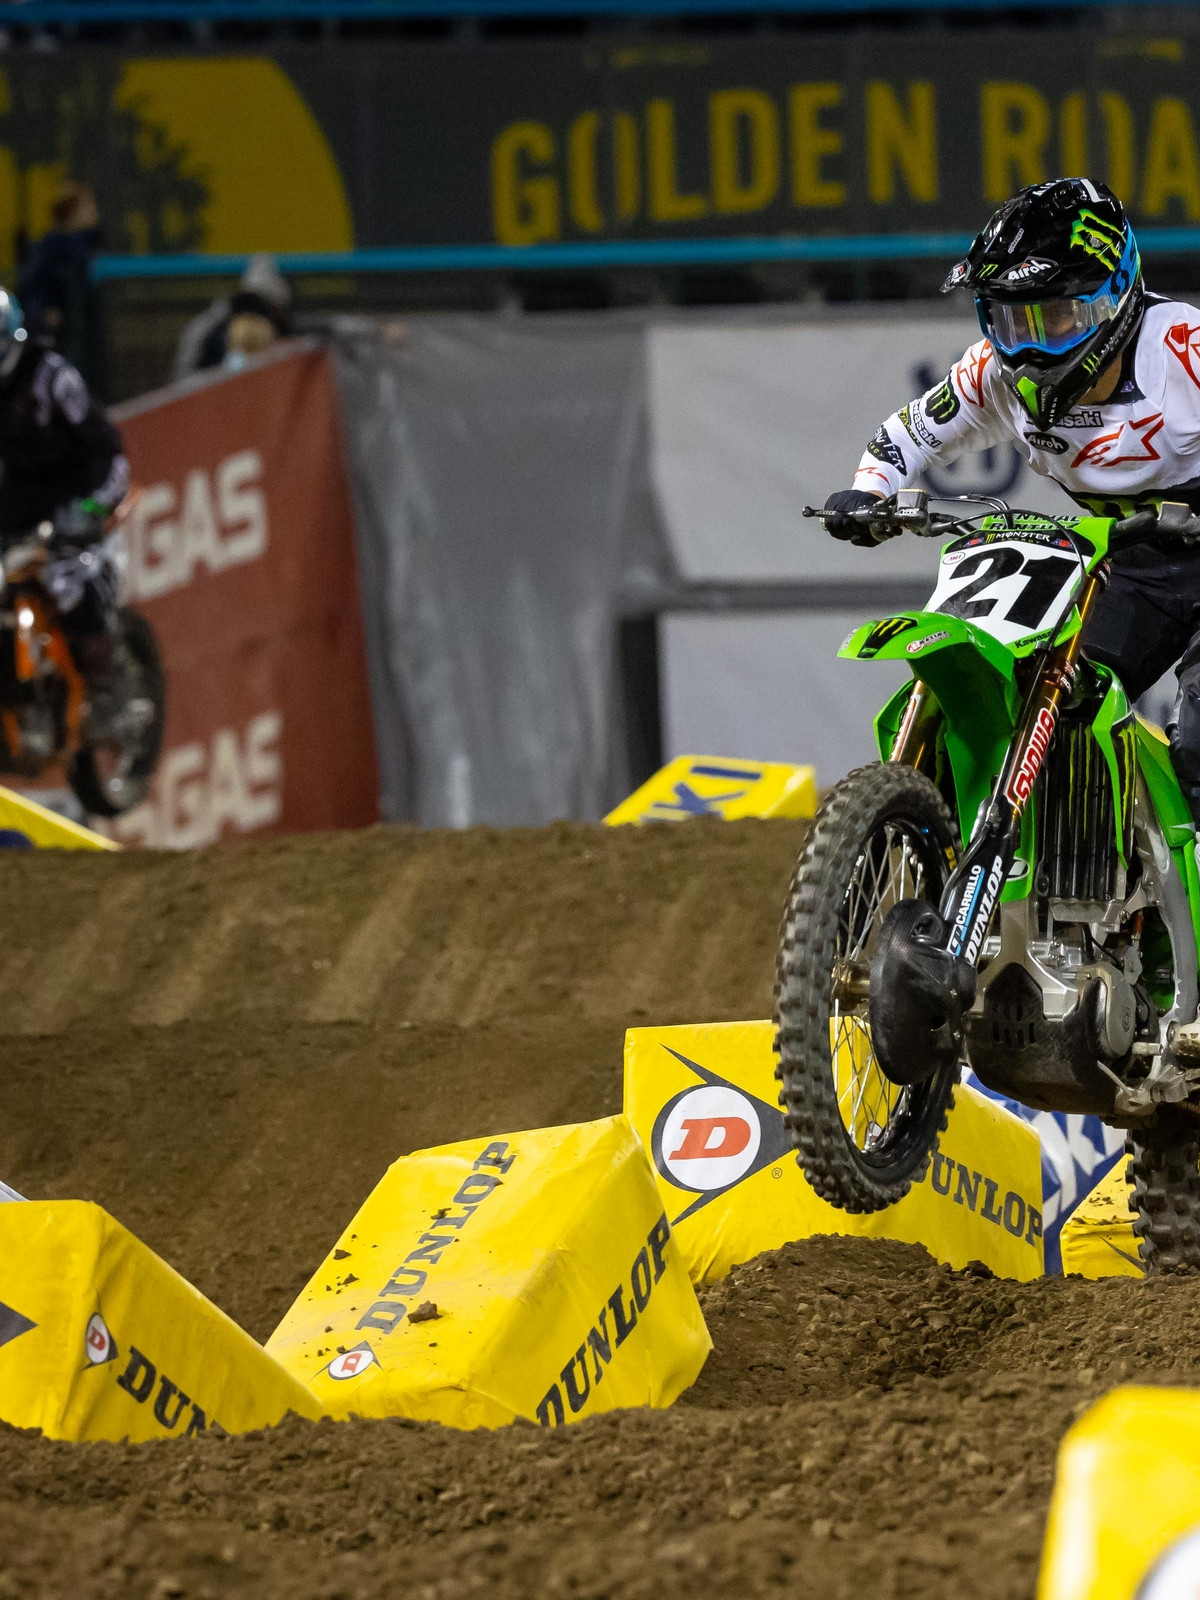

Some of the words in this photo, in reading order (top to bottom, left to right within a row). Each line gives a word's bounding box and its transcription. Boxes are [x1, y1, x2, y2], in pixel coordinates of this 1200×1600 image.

[1008, 260, 1051, 280] Airoh
[1028, 434, 1063, 451] Airoh
[935, 547, 1080, 630] 21
[1013, 707, 1056, 803] SHOWA
[955, 864, 982, 925] CARRILLO
[965, 855, 1003, 967] DUNLOP
[668, 1117, 752, 1161] D
[355, 1141, 517, 1335] DUNLOP
[930, 1150, 1043, 1248] UNLOP
[536, 1211, 673, 1427] DUNLOP
[340, 1352, 363, 1374] D
